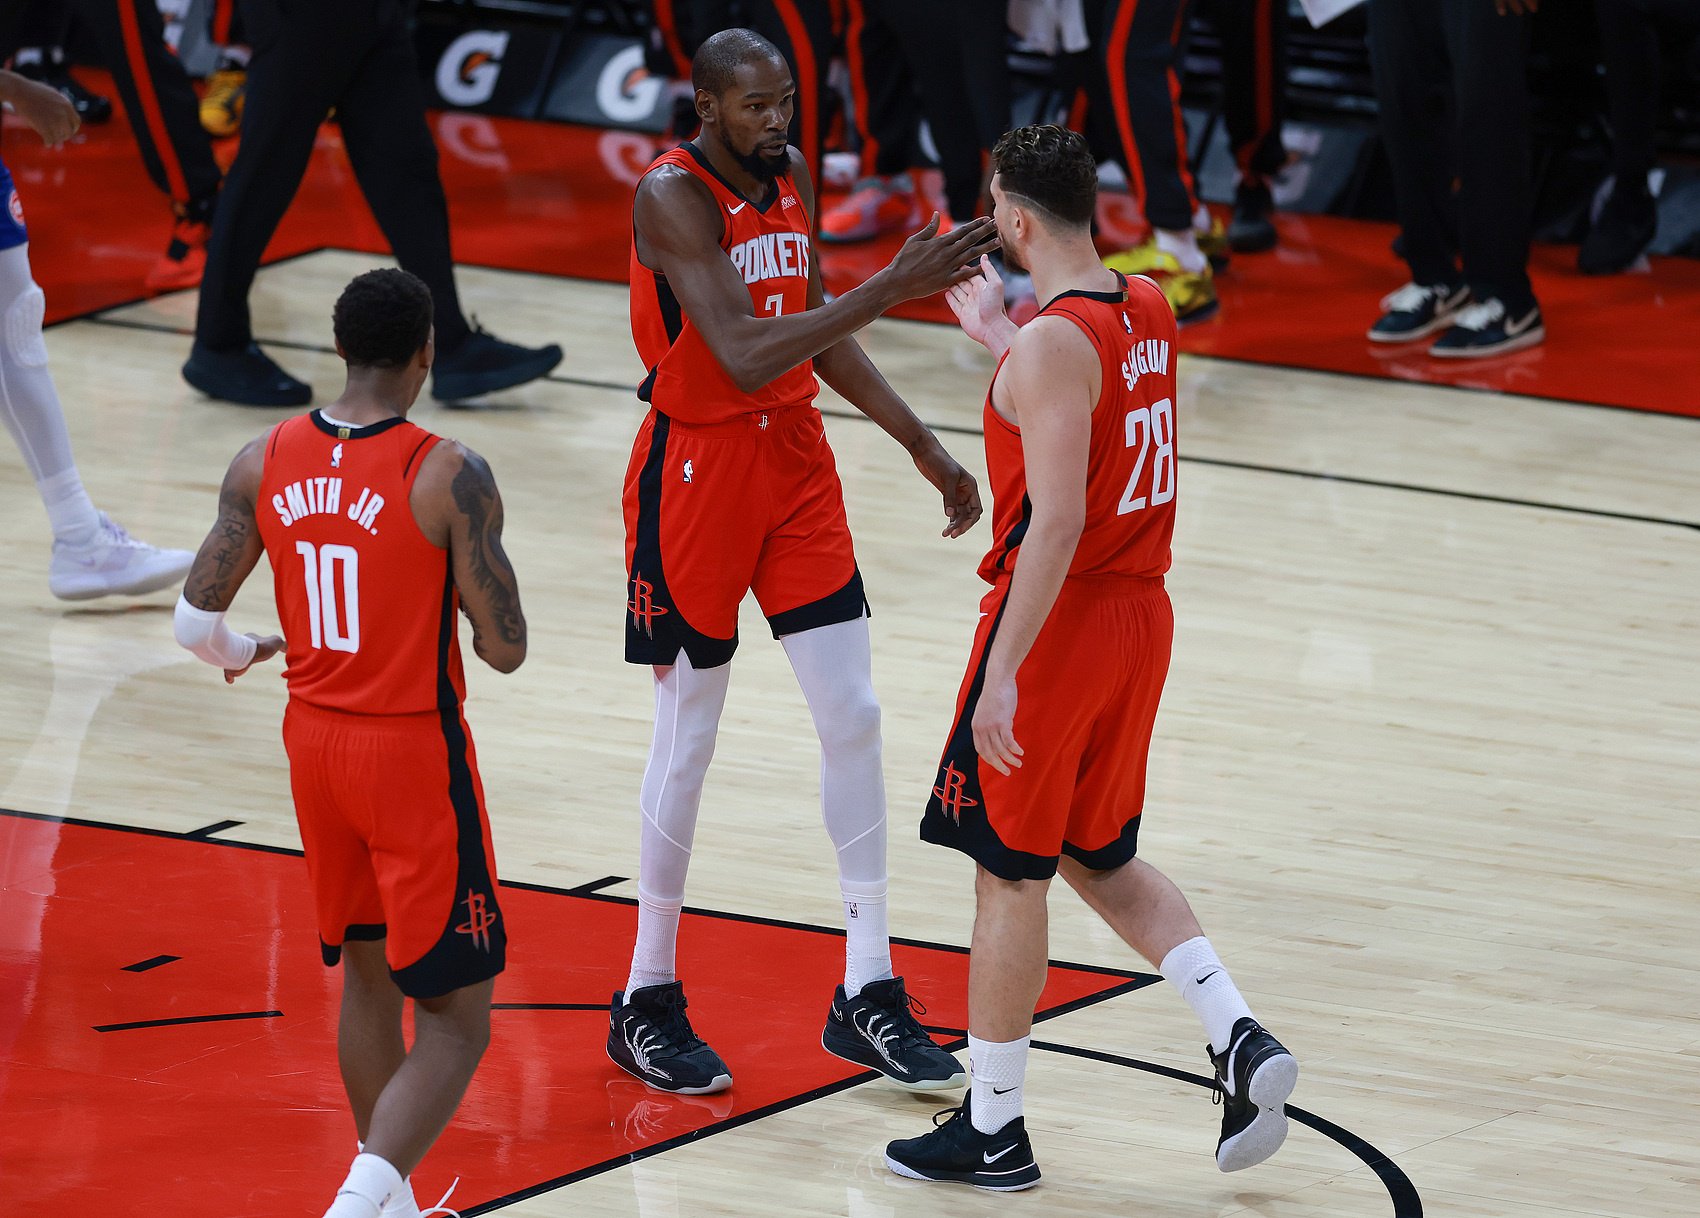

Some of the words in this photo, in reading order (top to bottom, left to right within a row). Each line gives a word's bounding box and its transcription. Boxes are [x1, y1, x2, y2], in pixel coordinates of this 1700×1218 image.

[435, 30, 510, 106] G
[596, 44, 662, 122] G
[764, 293, 784, 317] 7
[1116, 397, 1175, 516] 28
[272, 476, 343, 527] SMITH
[347, 487, 385, 536] JR.
[295, 540, 360, 655] 10
